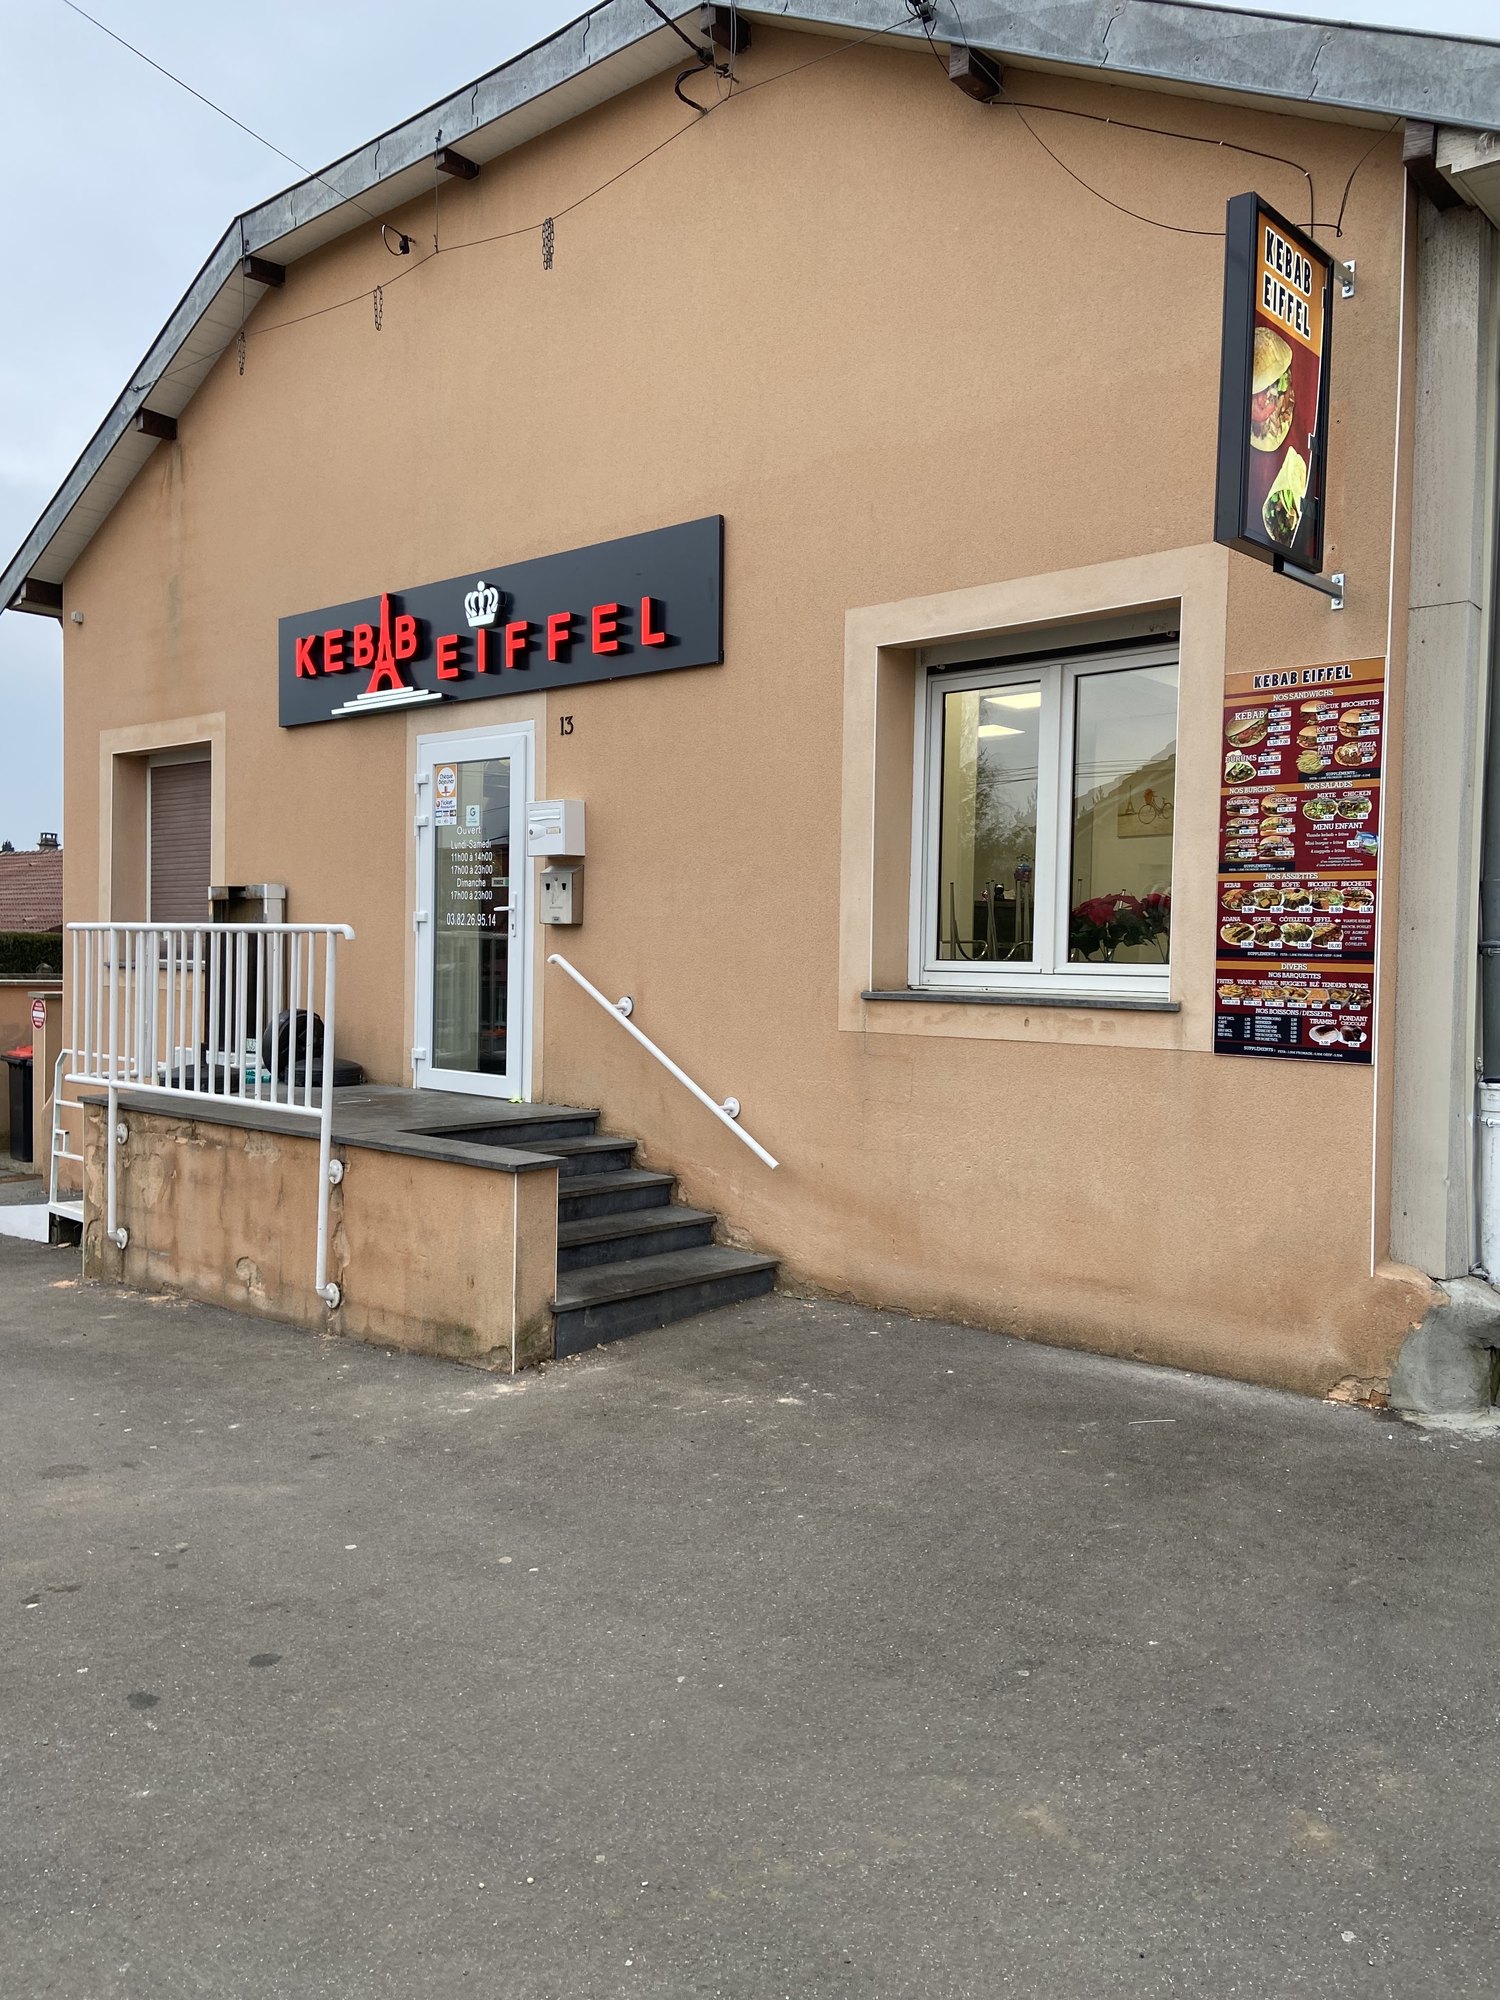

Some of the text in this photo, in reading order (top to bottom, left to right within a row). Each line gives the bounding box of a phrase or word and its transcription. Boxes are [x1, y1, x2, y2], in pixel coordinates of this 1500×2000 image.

[1265, 227, 1312, 297] KEBAB
[1263, 271, 1310, 340] EIFFEL
[437, 596, 665, 680] EIFFEL
[1254, 665, 1352, 689] KEBAB EIFFEL
[1273, 689, 1334, 701] NOS SANDWICHS
[1235, 711, 1265, 720] KEBAB
[559, 716, 574, 736] 13
[1305, 781, 1353, 790] NOS SALADES
[457, 826, 482, 835] Ouvert
[450, 840, 492, 850] Lundi-Samedi
[451, 851, 493, 862] 11h00 à 14h00
[451, 864, 493, 875] 17h00 à 23h00
[456, 878, 487, 888] Dimanche
[451, 890, 493, 900] 17h00 à 23h00
[446, 912, 497, 926] 03.82.26.95.14
[1281, 962, 1308, 970] DIVERS
